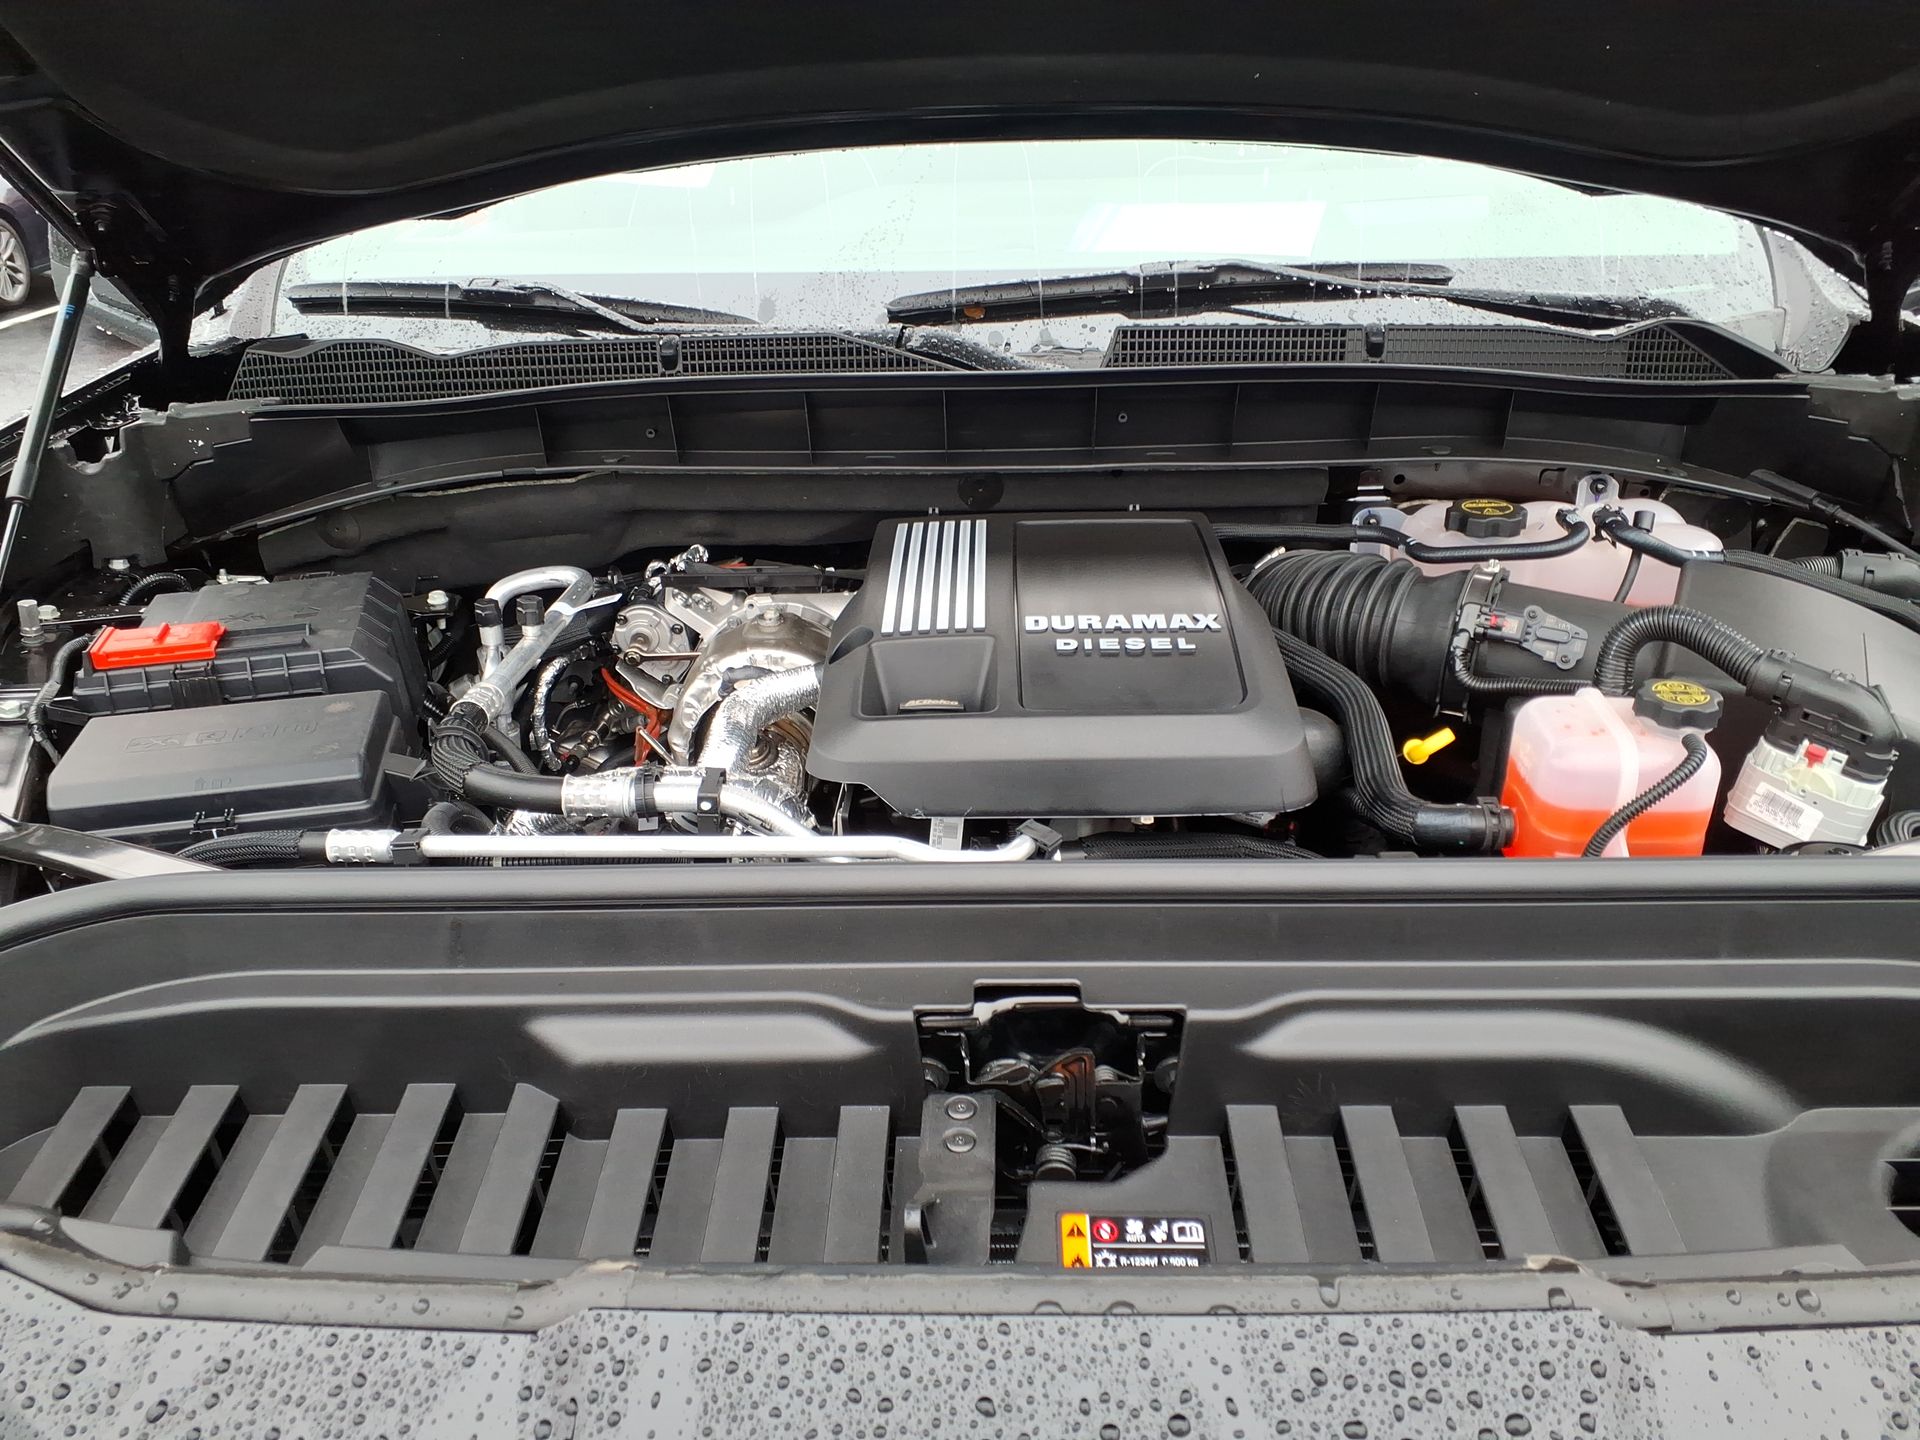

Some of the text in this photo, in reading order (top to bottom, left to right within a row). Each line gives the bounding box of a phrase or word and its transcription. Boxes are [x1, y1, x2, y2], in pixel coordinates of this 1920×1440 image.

[1024, 613, 1222, 633] DURAMAX
[1055, 637, 1196, 656] DIESEL
[1126, 1234, 1146, 1243] AUTO
